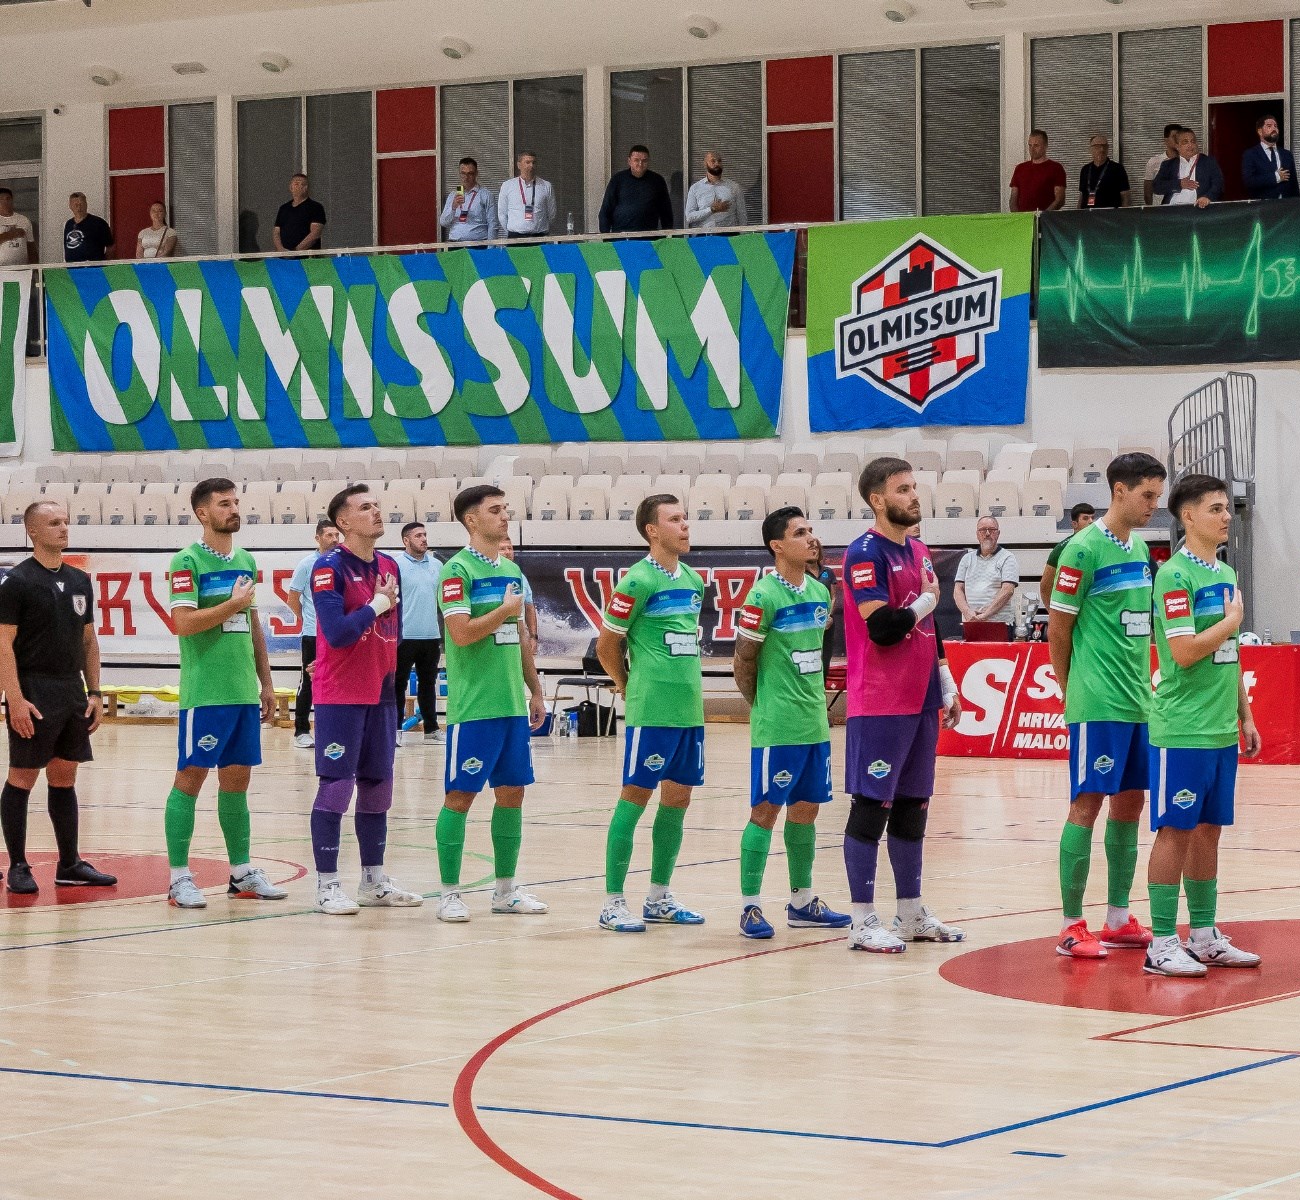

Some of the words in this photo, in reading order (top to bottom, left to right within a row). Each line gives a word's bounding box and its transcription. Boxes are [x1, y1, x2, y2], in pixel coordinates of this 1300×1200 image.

[84, 264, 744, 425] OLMISSUM
[847, 292, 987, 357] OLMISSUM
[1012, 732, 1069, 749] MALO
